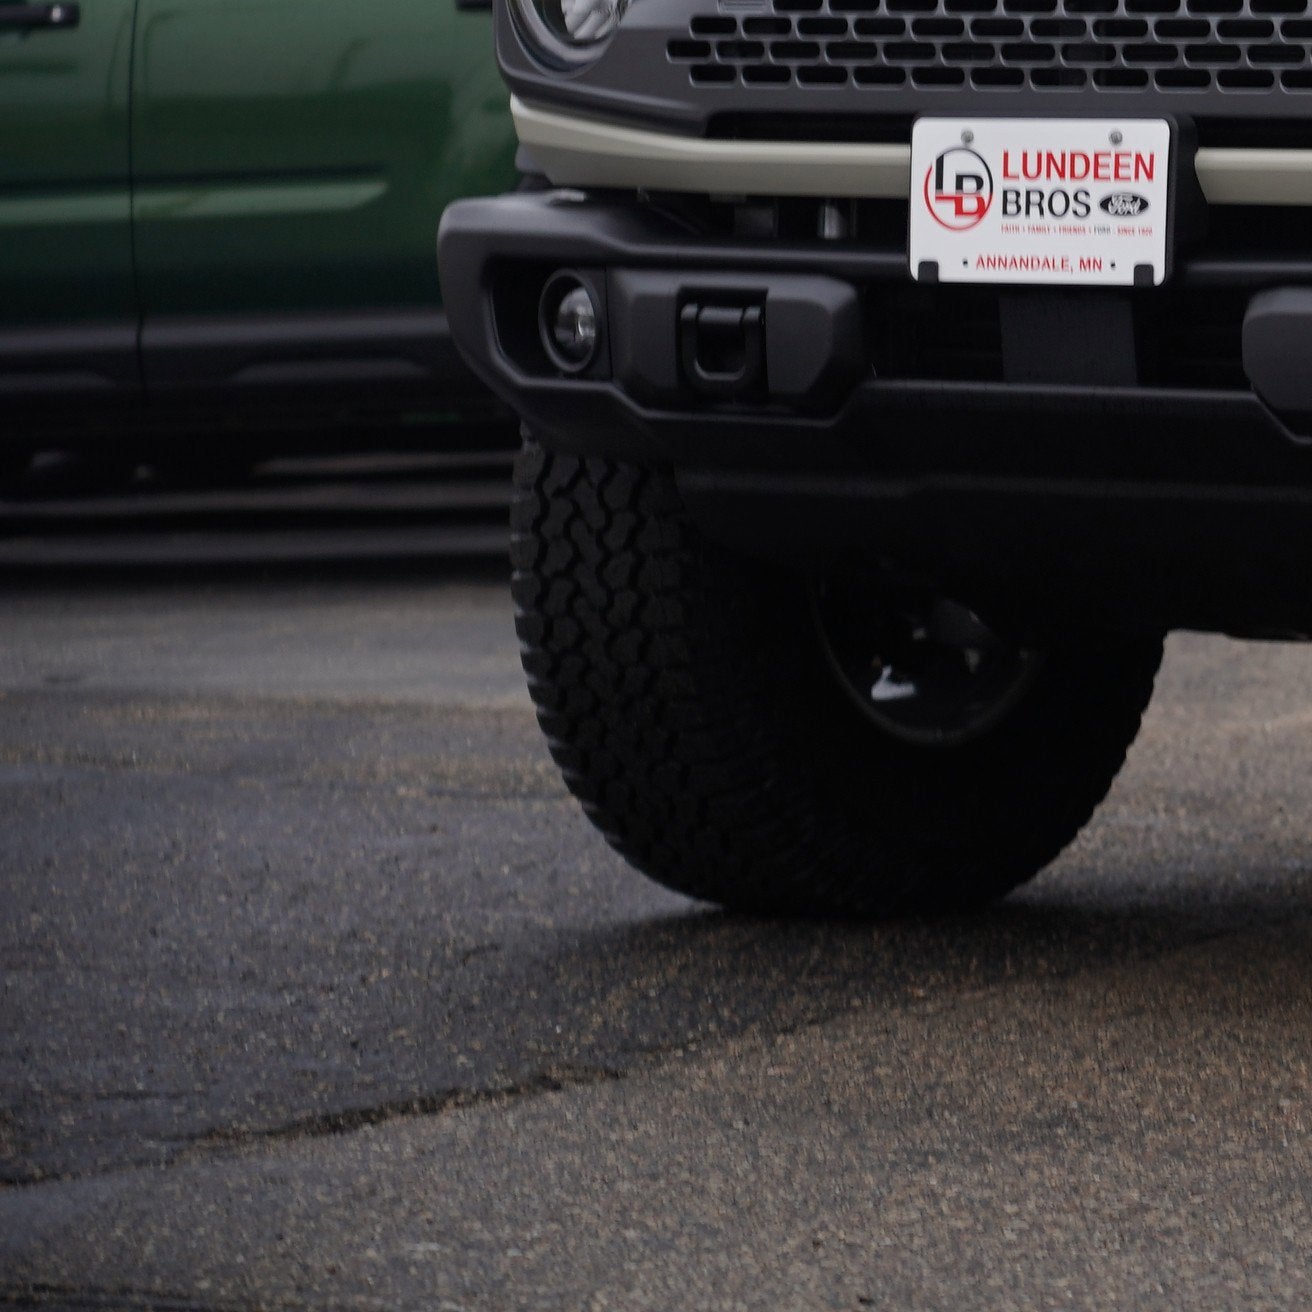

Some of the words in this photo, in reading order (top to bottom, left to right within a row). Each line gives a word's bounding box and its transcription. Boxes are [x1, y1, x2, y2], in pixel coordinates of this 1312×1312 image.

[1002, 149, 1155, 182] LUNDEEN
[1001, 188, 1092, 218] BROS
[976, 253, 1074, 274] ANNANDALE,
[1079, 255, 1103, 273] MN
